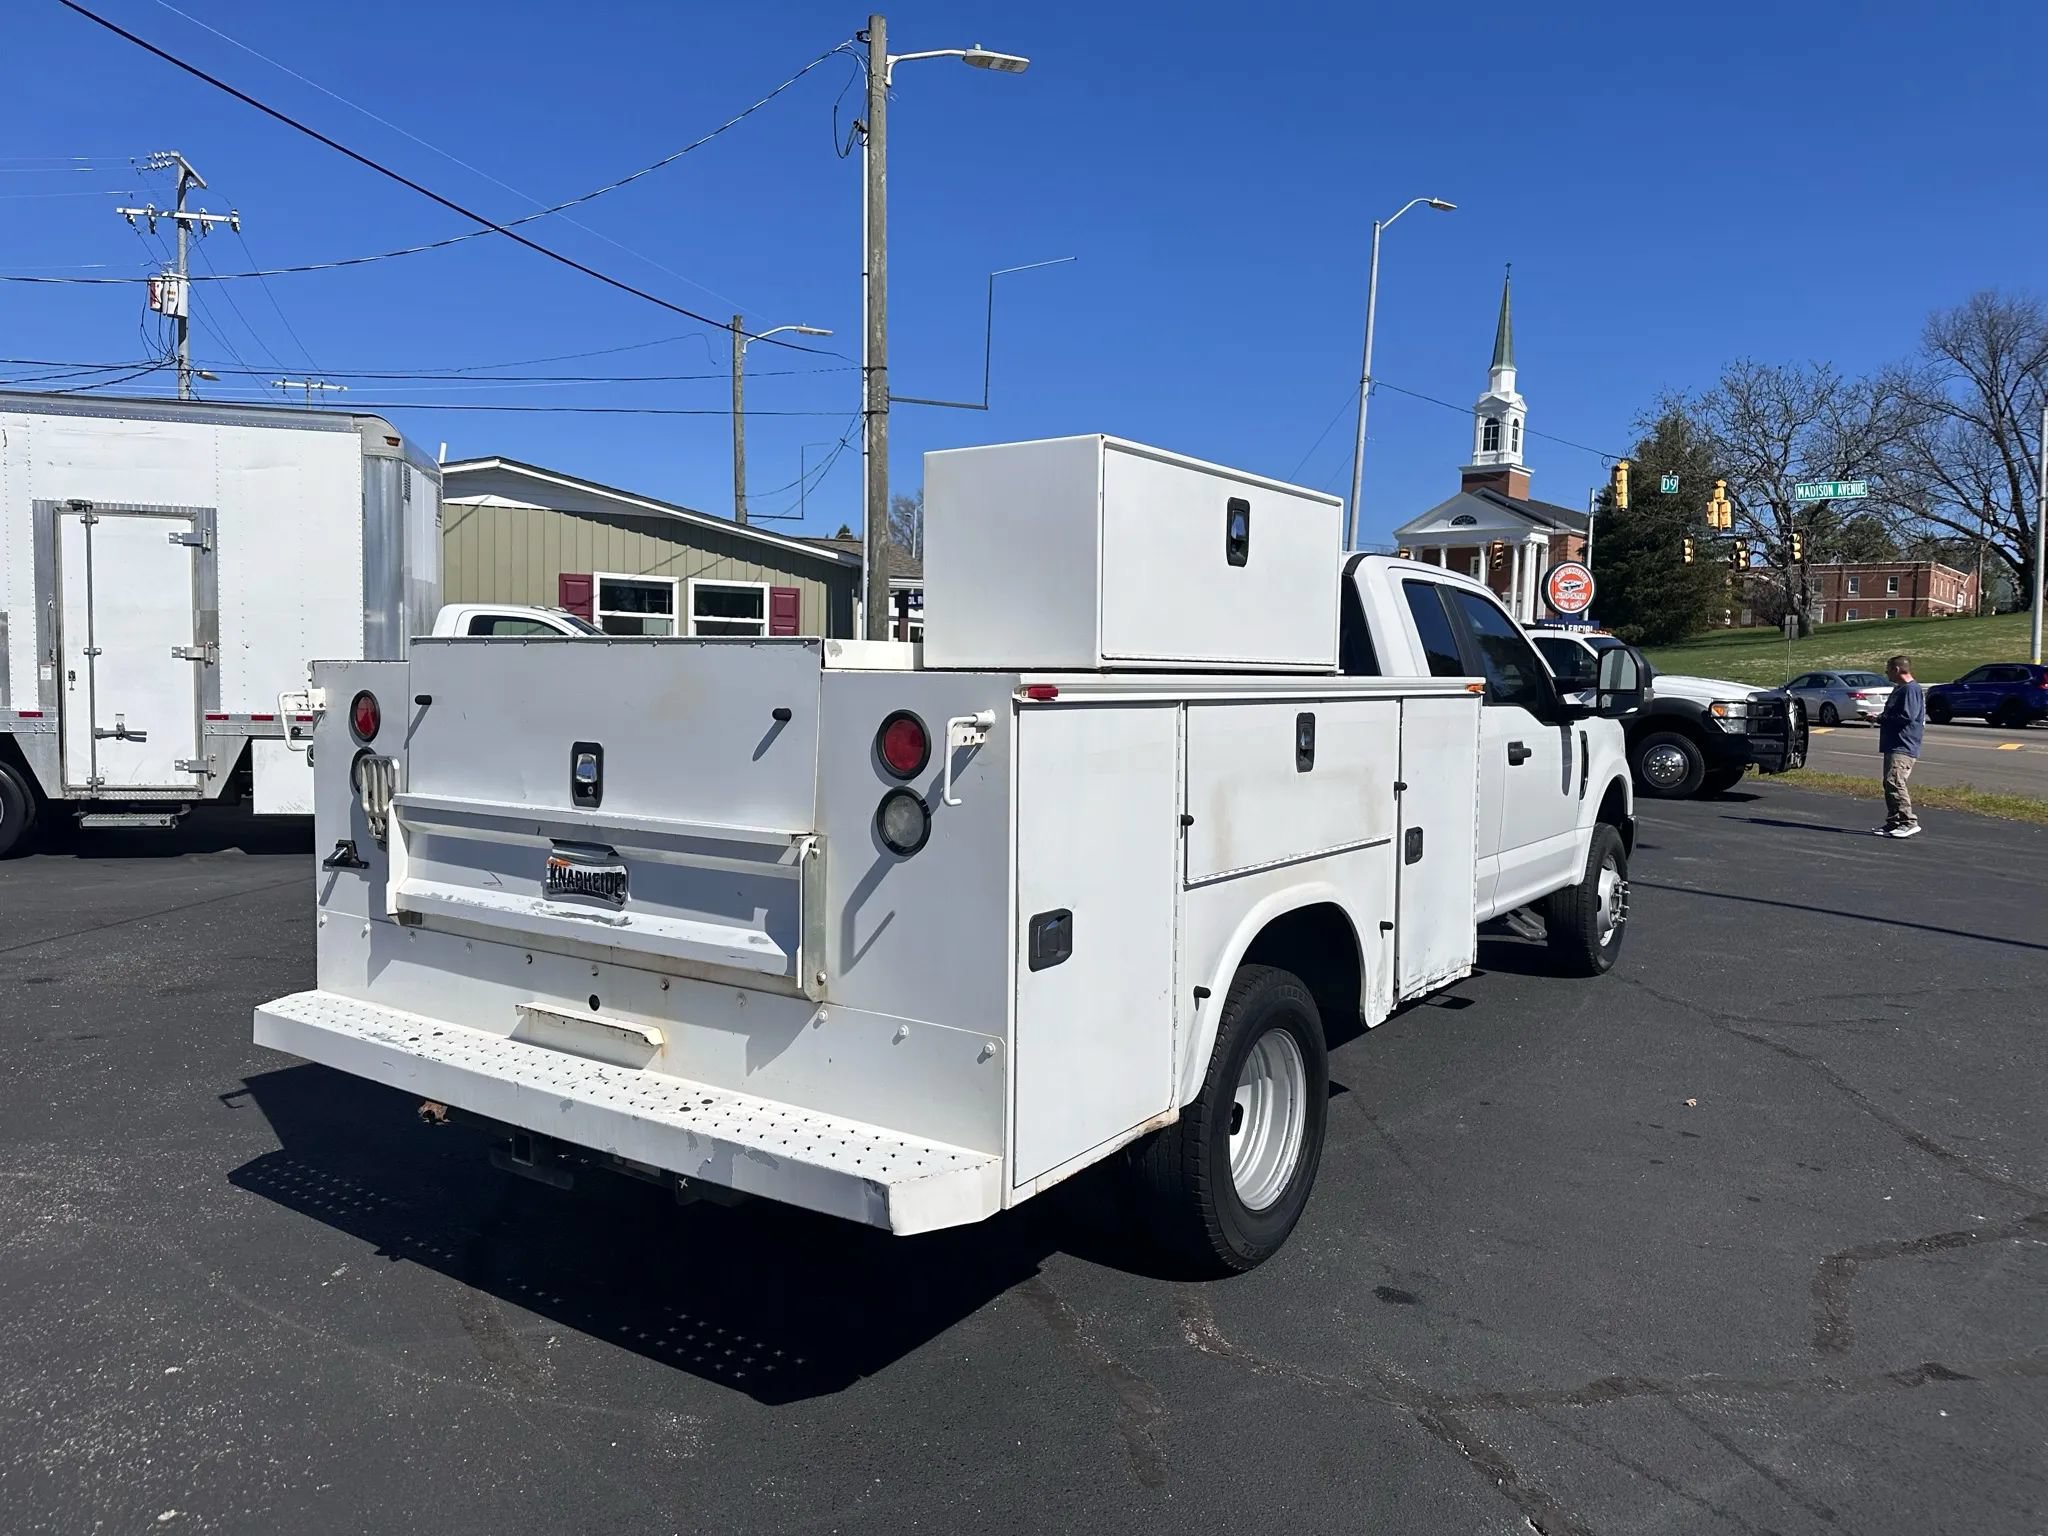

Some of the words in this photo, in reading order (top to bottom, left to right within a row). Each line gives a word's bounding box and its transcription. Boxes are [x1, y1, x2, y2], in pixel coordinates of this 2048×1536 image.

[1662, 477, 1677, 490] D9
[1797, 484, 1834, 498] MADISON
[1837, 482, 1865, 496] AVENUE
